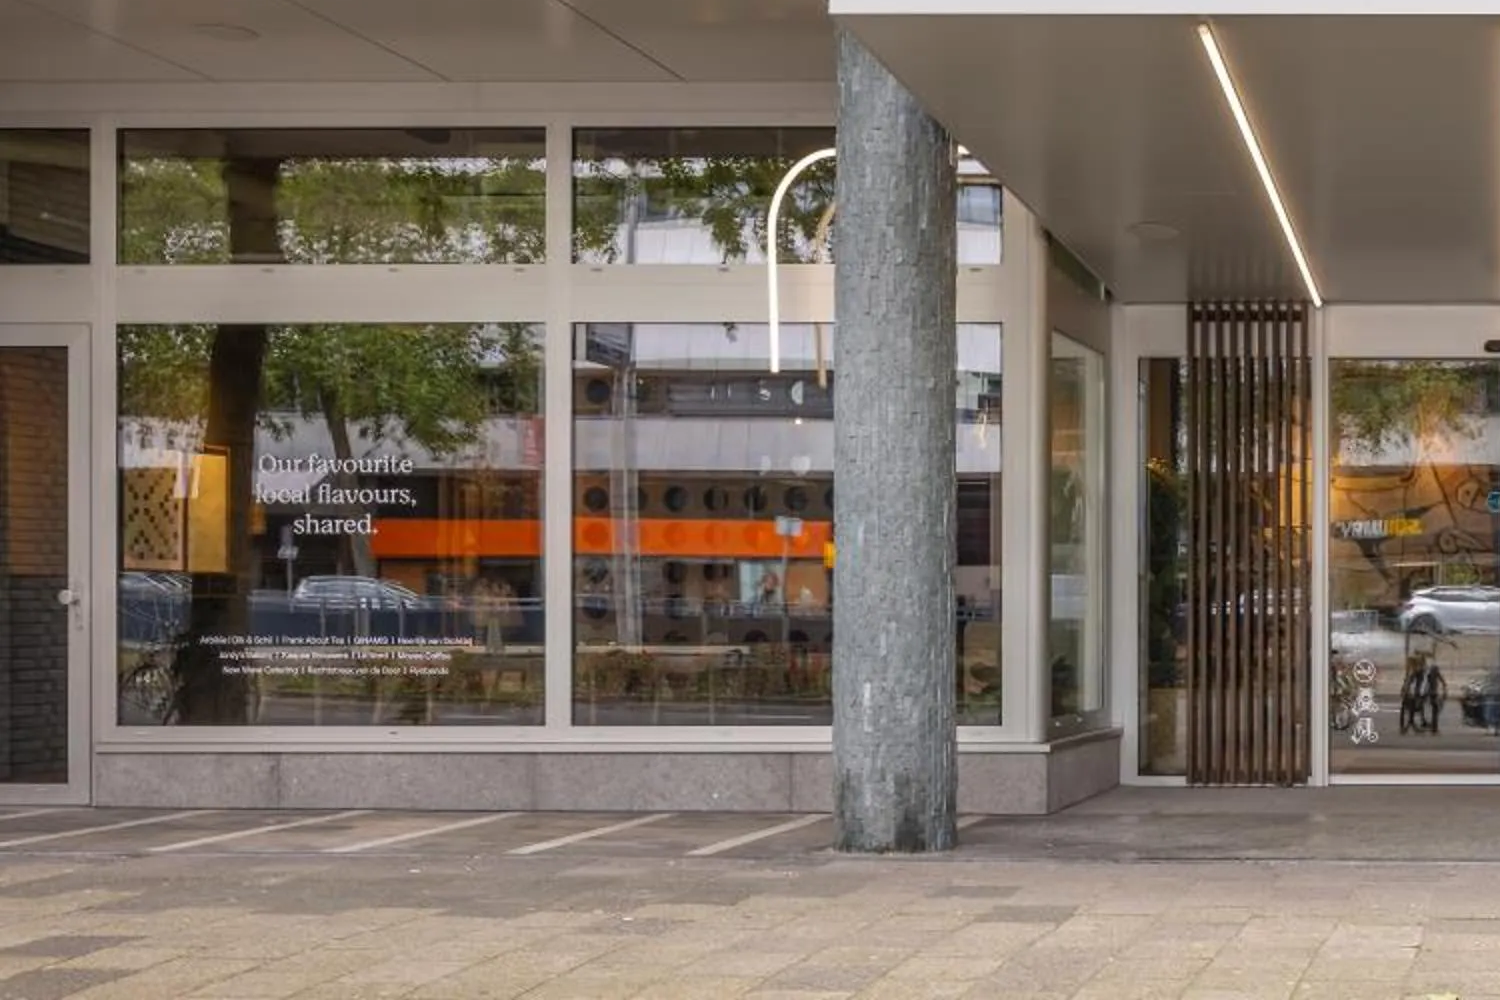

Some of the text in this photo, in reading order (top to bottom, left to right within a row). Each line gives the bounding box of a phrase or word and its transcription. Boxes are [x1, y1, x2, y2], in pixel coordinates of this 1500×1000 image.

[258, 452, 414, 473] Our favourite
[255, 483, 417, 508] local flavours,
[293, 513, 379, 535] shared.
